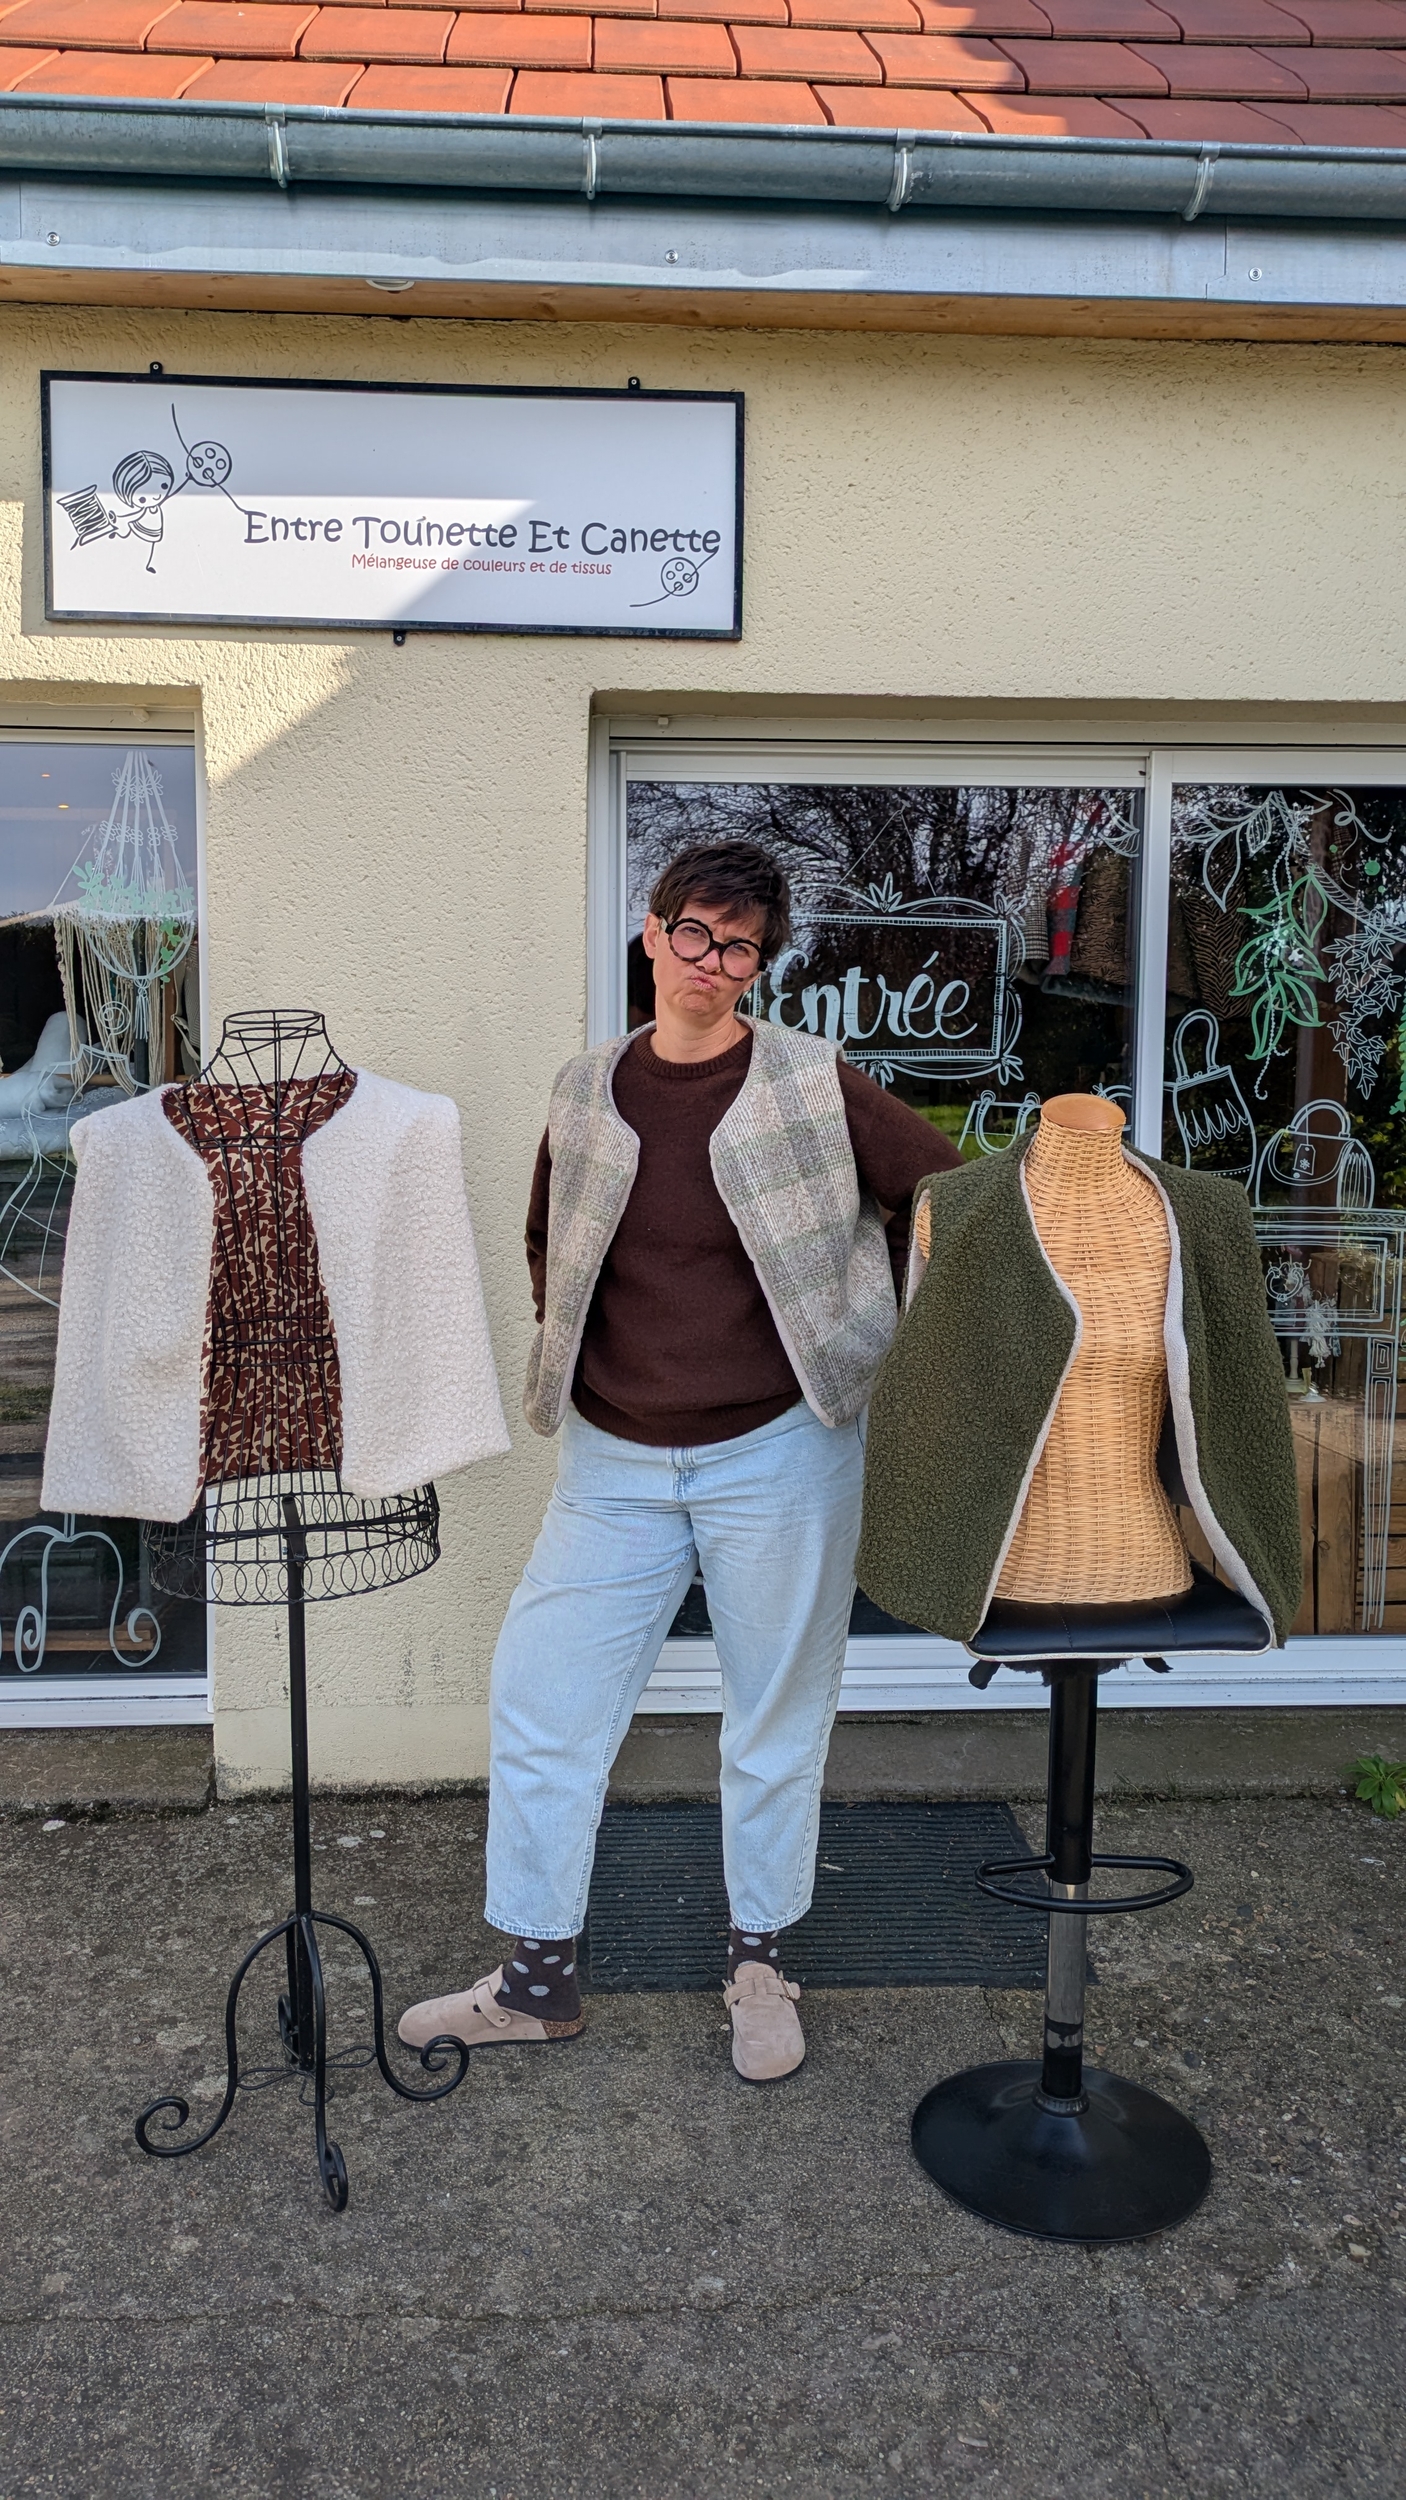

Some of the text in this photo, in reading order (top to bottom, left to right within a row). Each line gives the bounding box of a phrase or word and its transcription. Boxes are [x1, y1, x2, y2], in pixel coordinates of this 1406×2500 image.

[244, 510, 343, 544] Entre
[528, 520, 570, 553] Et
[581, 522, 721, 556] Canette
[351, 553, 612, 575] Mélangeuse de couleurs et de tissus
[768, 949, 978, 1046] Entrée
